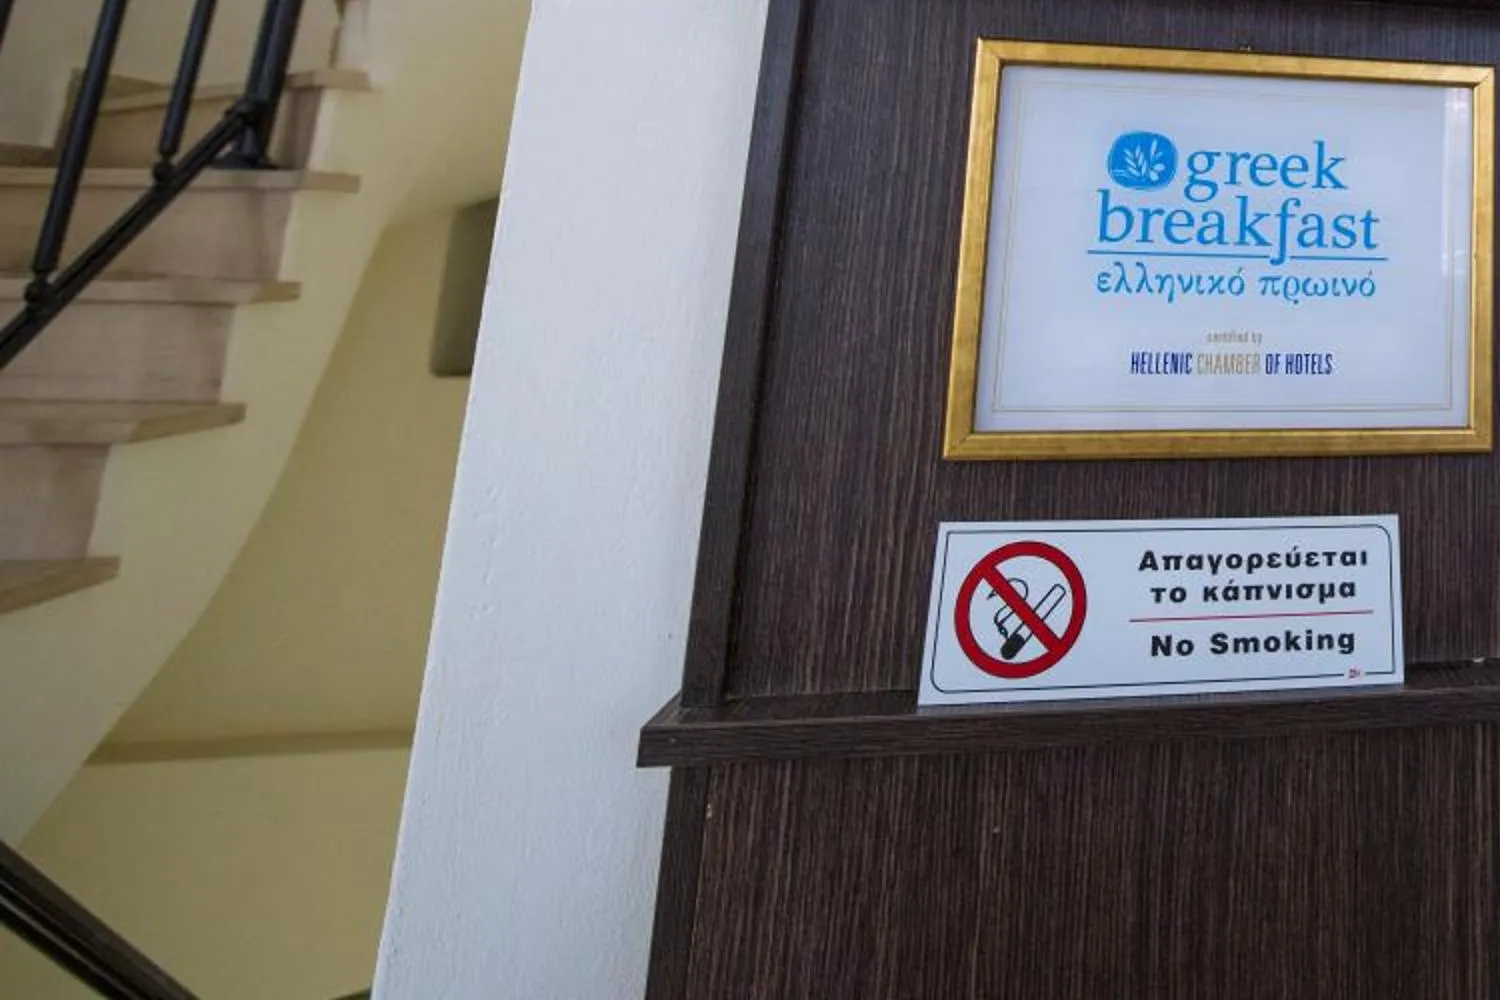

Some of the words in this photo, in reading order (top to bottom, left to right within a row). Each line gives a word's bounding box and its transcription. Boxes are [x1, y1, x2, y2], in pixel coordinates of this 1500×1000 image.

[1184, 140, 1348, 202] greek
[1097, 189, 1380, 266] breakfast
[1097, 262, 1245, 303] ελληνικό
[1258, 269, 1377, 305] πρωινό
[1207, 331, 1249, 344] certified
[1251, 331, 1263, 346] by
[1131, 351, 1193, 375] HELLENIC
[1197, 353, 1261, 376] CHAMBER
[1265, 353, 1281, 375] OF
[1285, 353, 1333, 375] HOTELS
[1138, 546, 1368, 575] Απαγορεύεται
[1150, 586, 1187, 604] το
[1202, 578, 1357, 605] κάπνισμα
[1150, 634, 1195, 658] No
[1210, 630, 1356, 657] Smoking
